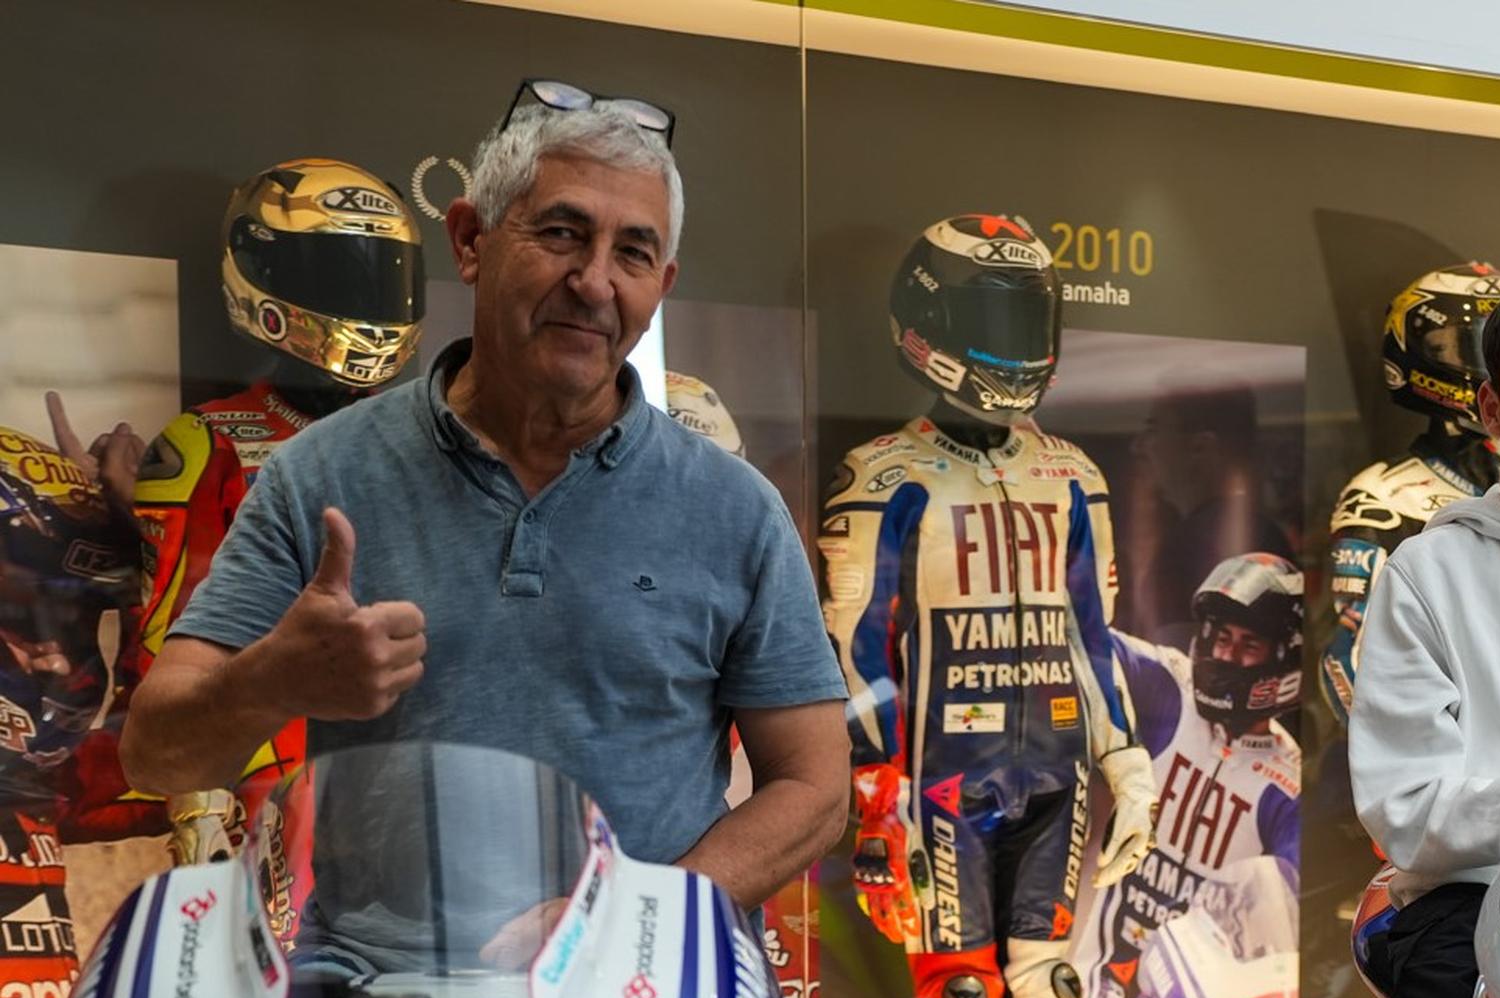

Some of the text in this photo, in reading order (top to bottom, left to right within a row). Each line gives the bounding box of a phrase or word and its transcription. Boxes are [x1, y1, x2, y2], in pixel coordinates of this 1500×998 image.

[1050, 222, 1154, 276] 2010
[1062, 281, 1131, 306] amaha
[932, 435, 981, 466] YAMAHA
[950, 501, 1058, 597] FIAT
[945, 610, 1067, 651] YAMAHA
[946, 660, 1073, 691] PETRONAS
[1063, 761, 1089, 900] DAINESE
[1155, 752, 1253, 871] FIAT
[932, 815, 963, 951] DAINESE
[4, 922, 77, 953] LOTU
